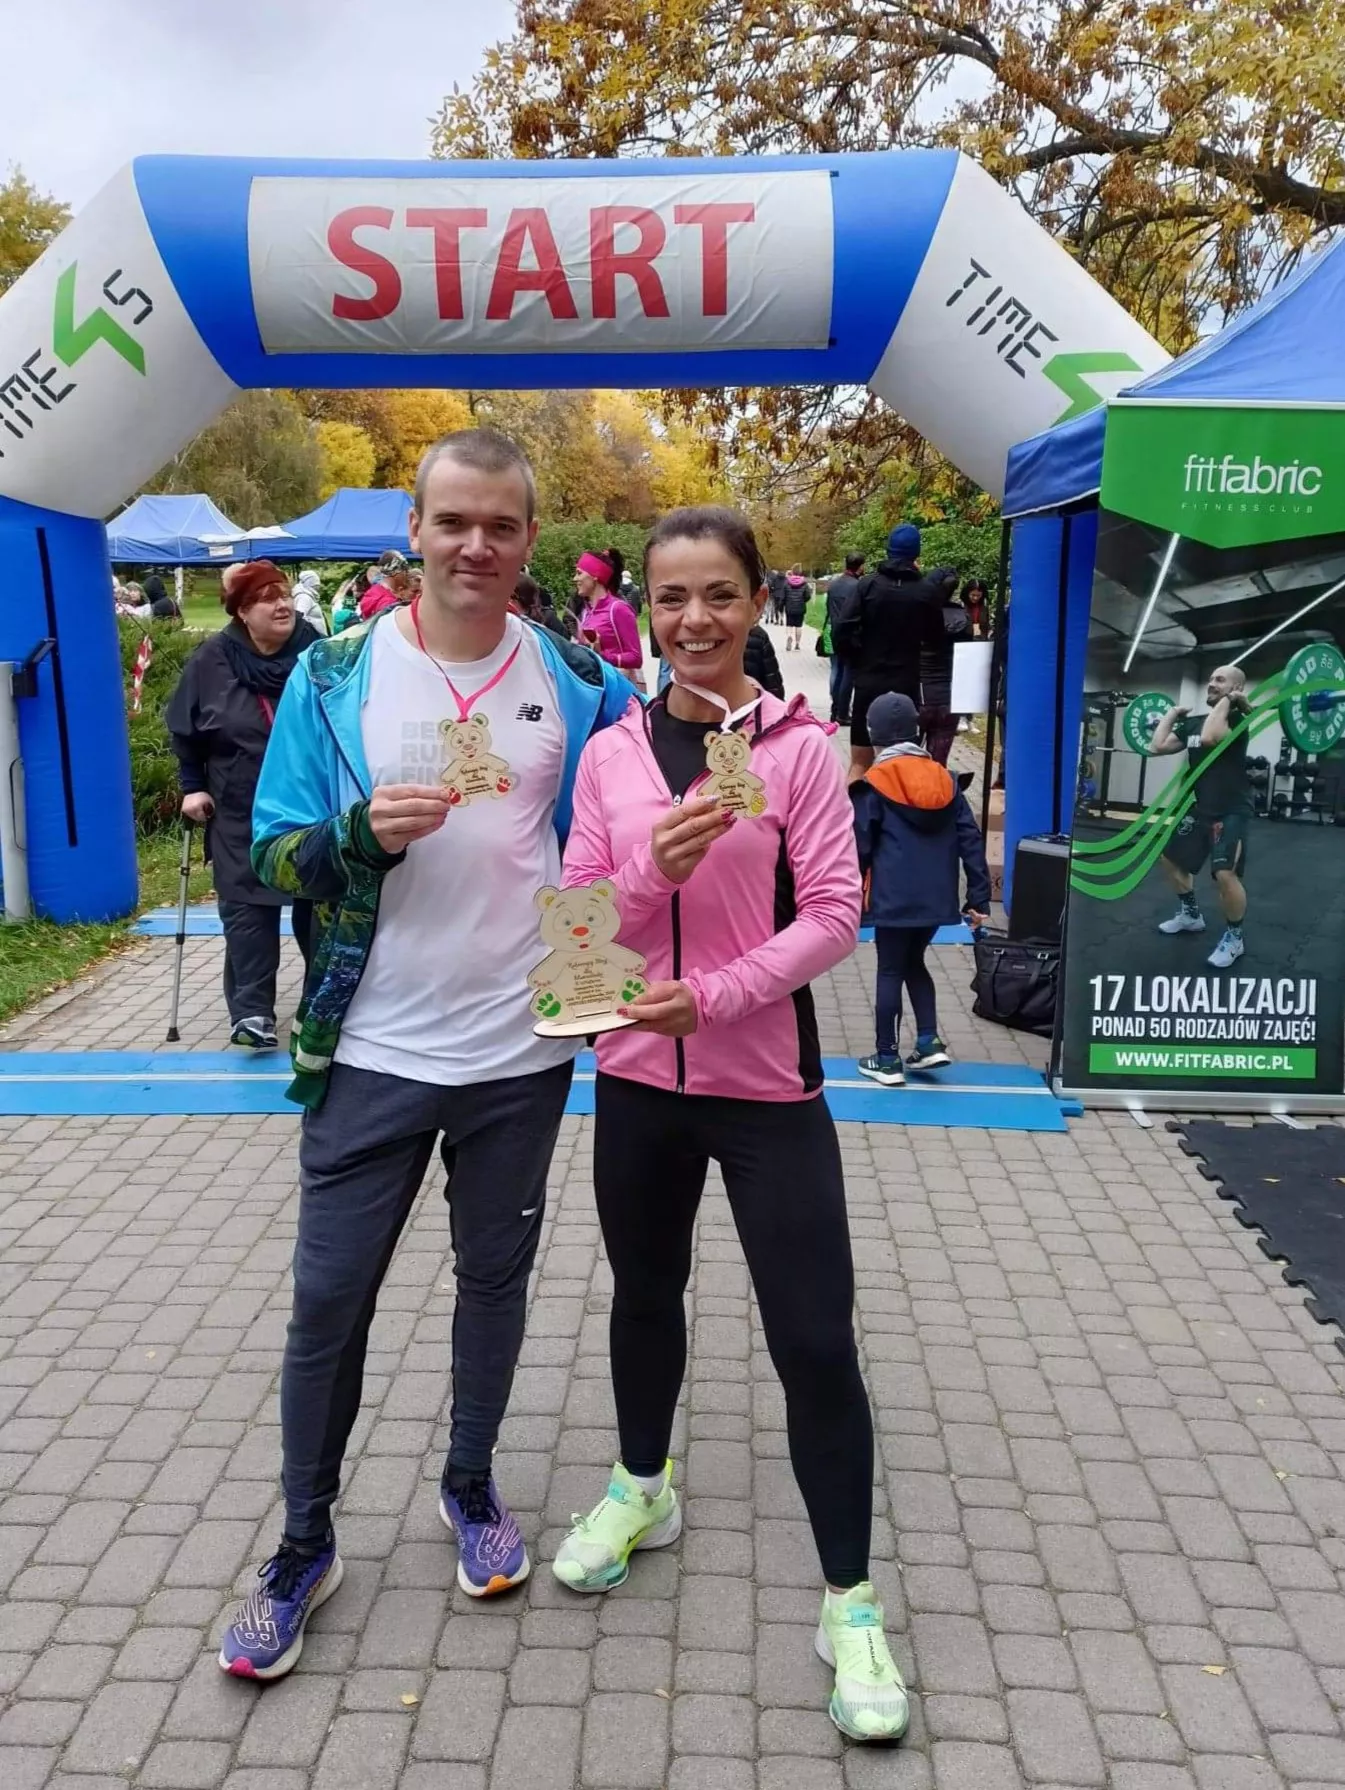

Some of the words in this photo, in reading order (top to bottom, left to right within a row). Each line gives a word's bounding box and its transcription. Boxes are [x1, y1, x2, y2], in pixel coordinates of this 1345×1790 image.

[327, 202, 756, 320] START
[1184, 454, 1322, 495] fitfabric
[1089, 975, 1126, 1011] 17
[1134, 976, 1317, 1015] LOKALIZACJI
[1092, 1016, 1145, 1038] PONAD
[1150, 1017, 1170, 1038] 50
[1175, 1015, 1260, 1041] RODZAJÓW
[1264, 1018, 1316, 1044] ZAJĘĆ!
[1115, 1051, 1293, 1070] WWW.FITFABRIC.PL
